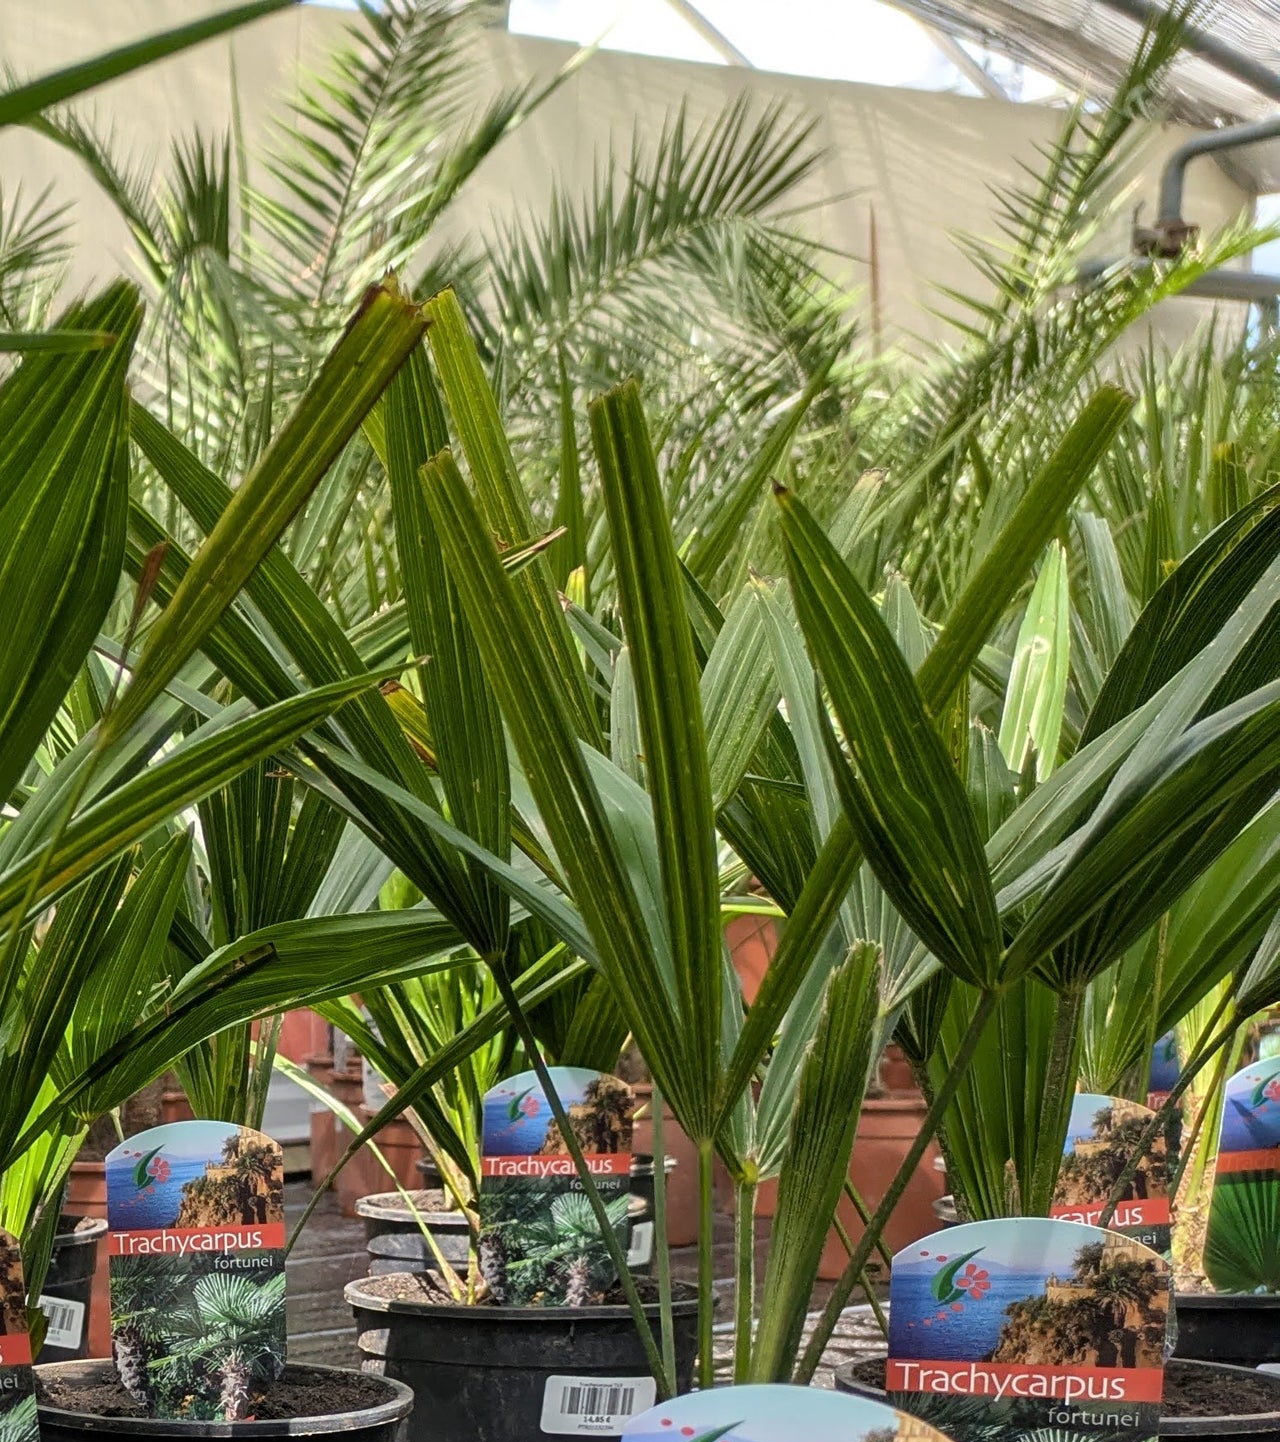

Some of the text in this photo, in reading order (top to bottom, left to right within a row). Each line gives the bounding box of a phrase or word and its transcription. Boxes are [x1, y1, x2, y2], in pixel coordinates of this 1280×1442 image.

[113, 1230, 262, 1257] Trachycarpus
[214, 1255, 273, 1270] fortunei
[895, 1362, 1126, 1405] Trachycarpus
[1048, 1407, 1140, 1427] fortunei
